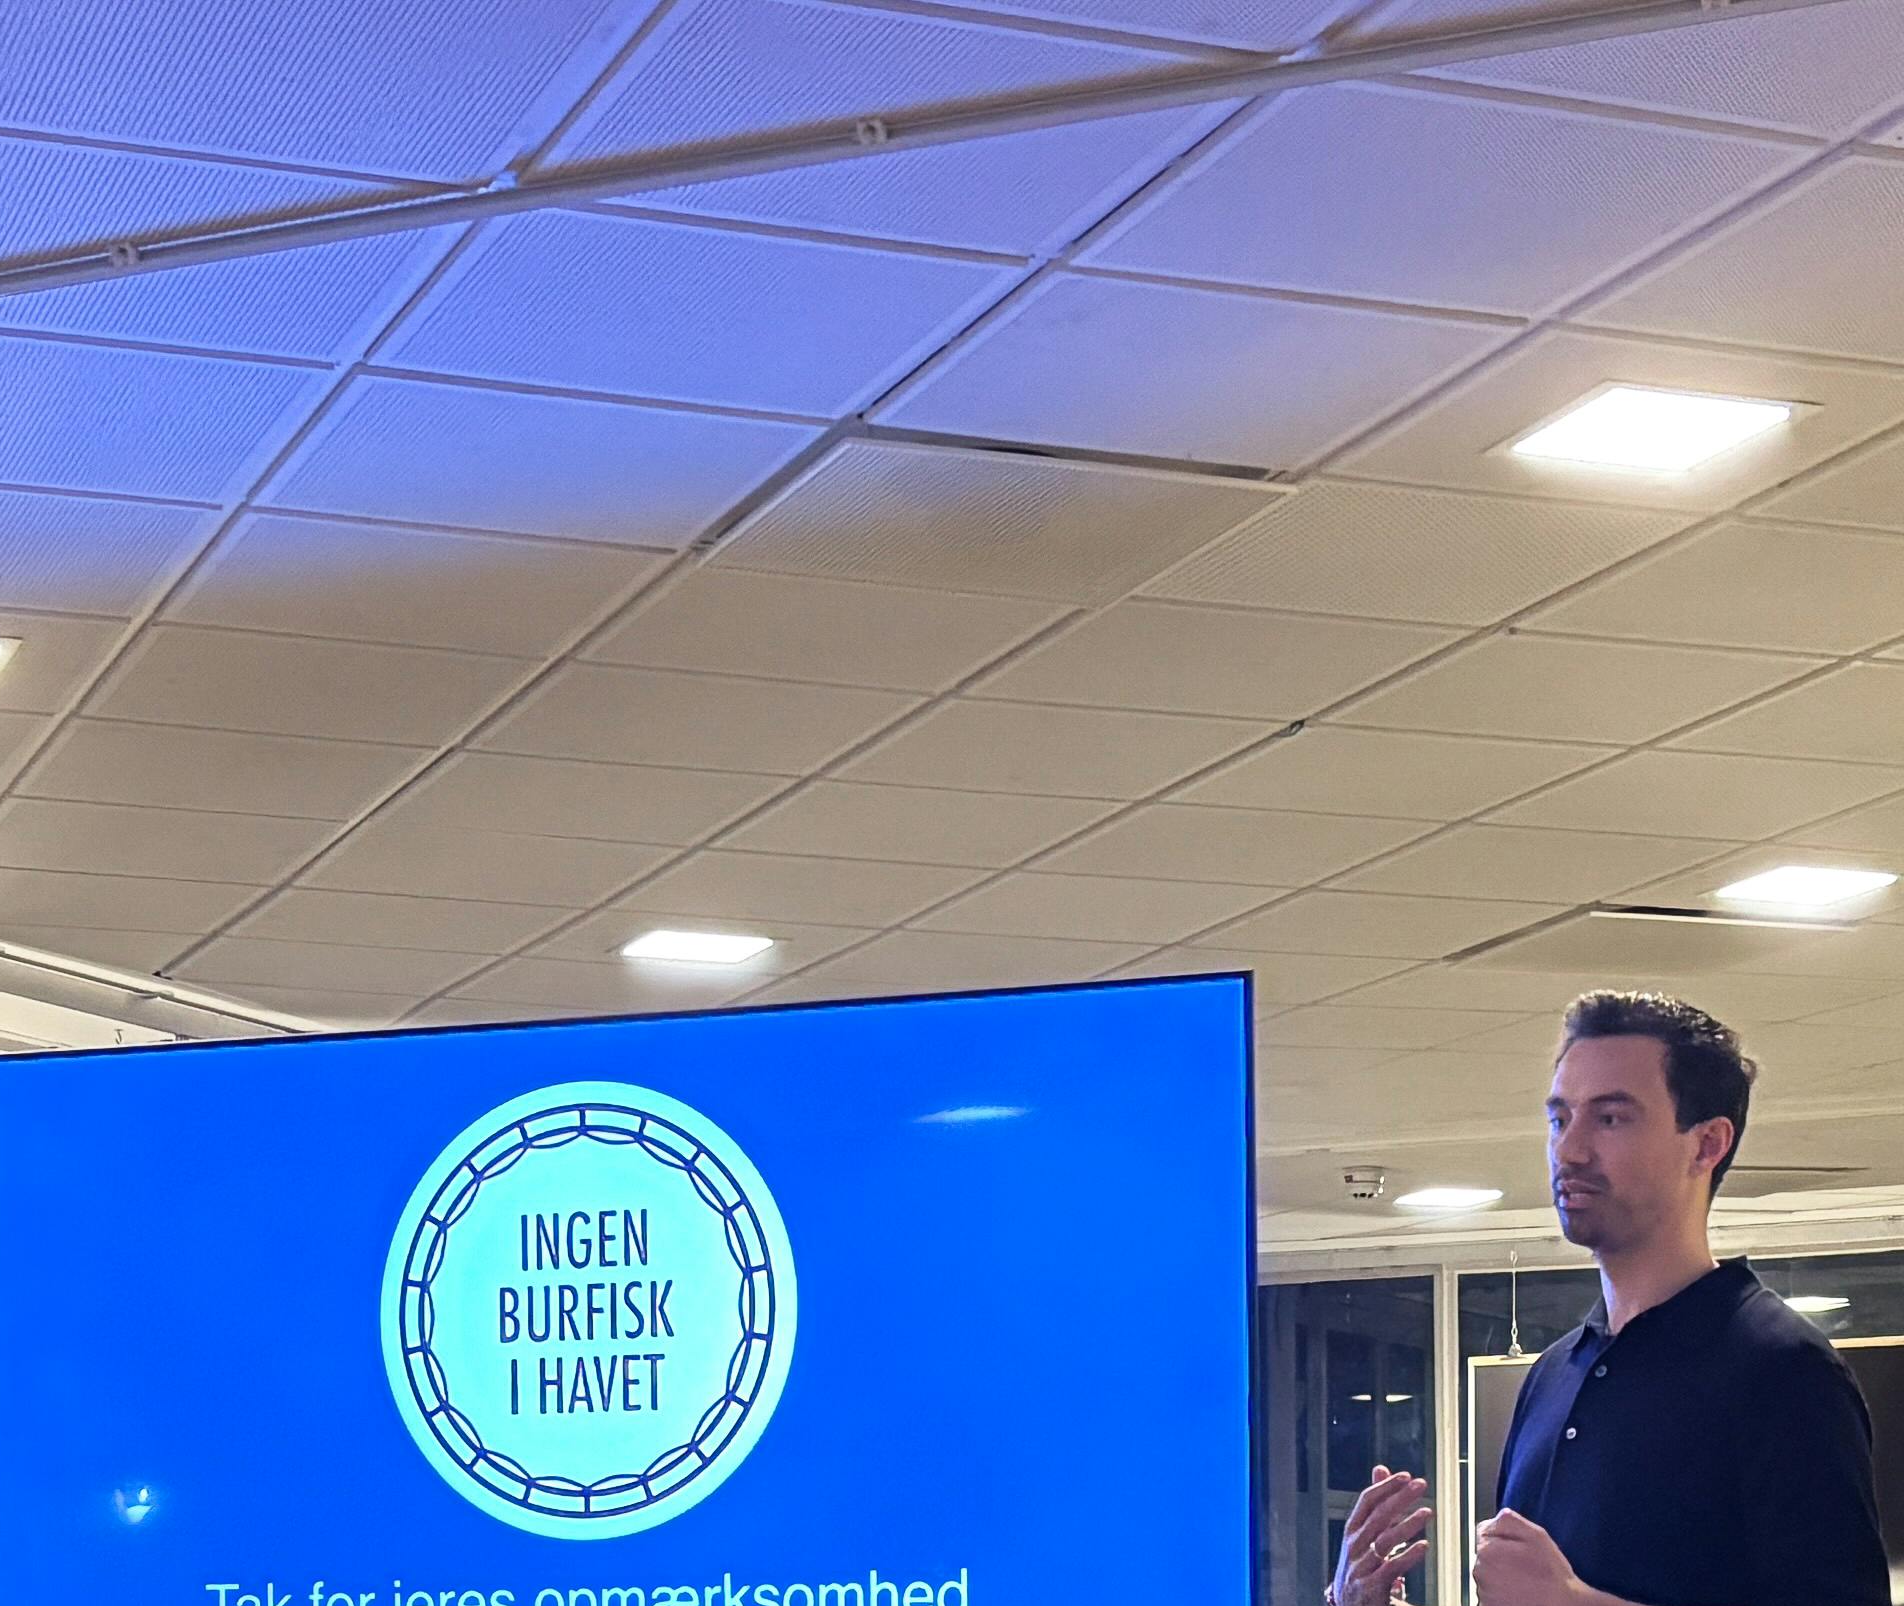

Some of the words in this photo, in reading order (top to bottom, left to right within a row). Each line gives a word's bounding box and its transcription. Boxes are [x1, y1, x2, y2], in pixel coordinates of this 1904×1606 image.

[519, 1207, 649, 1272] INGEN
[498, 1279, 676, 1344] BURFISK
[510, 1358, 520, 1416] I
[538, 1352, 666, 1416] HAVET
